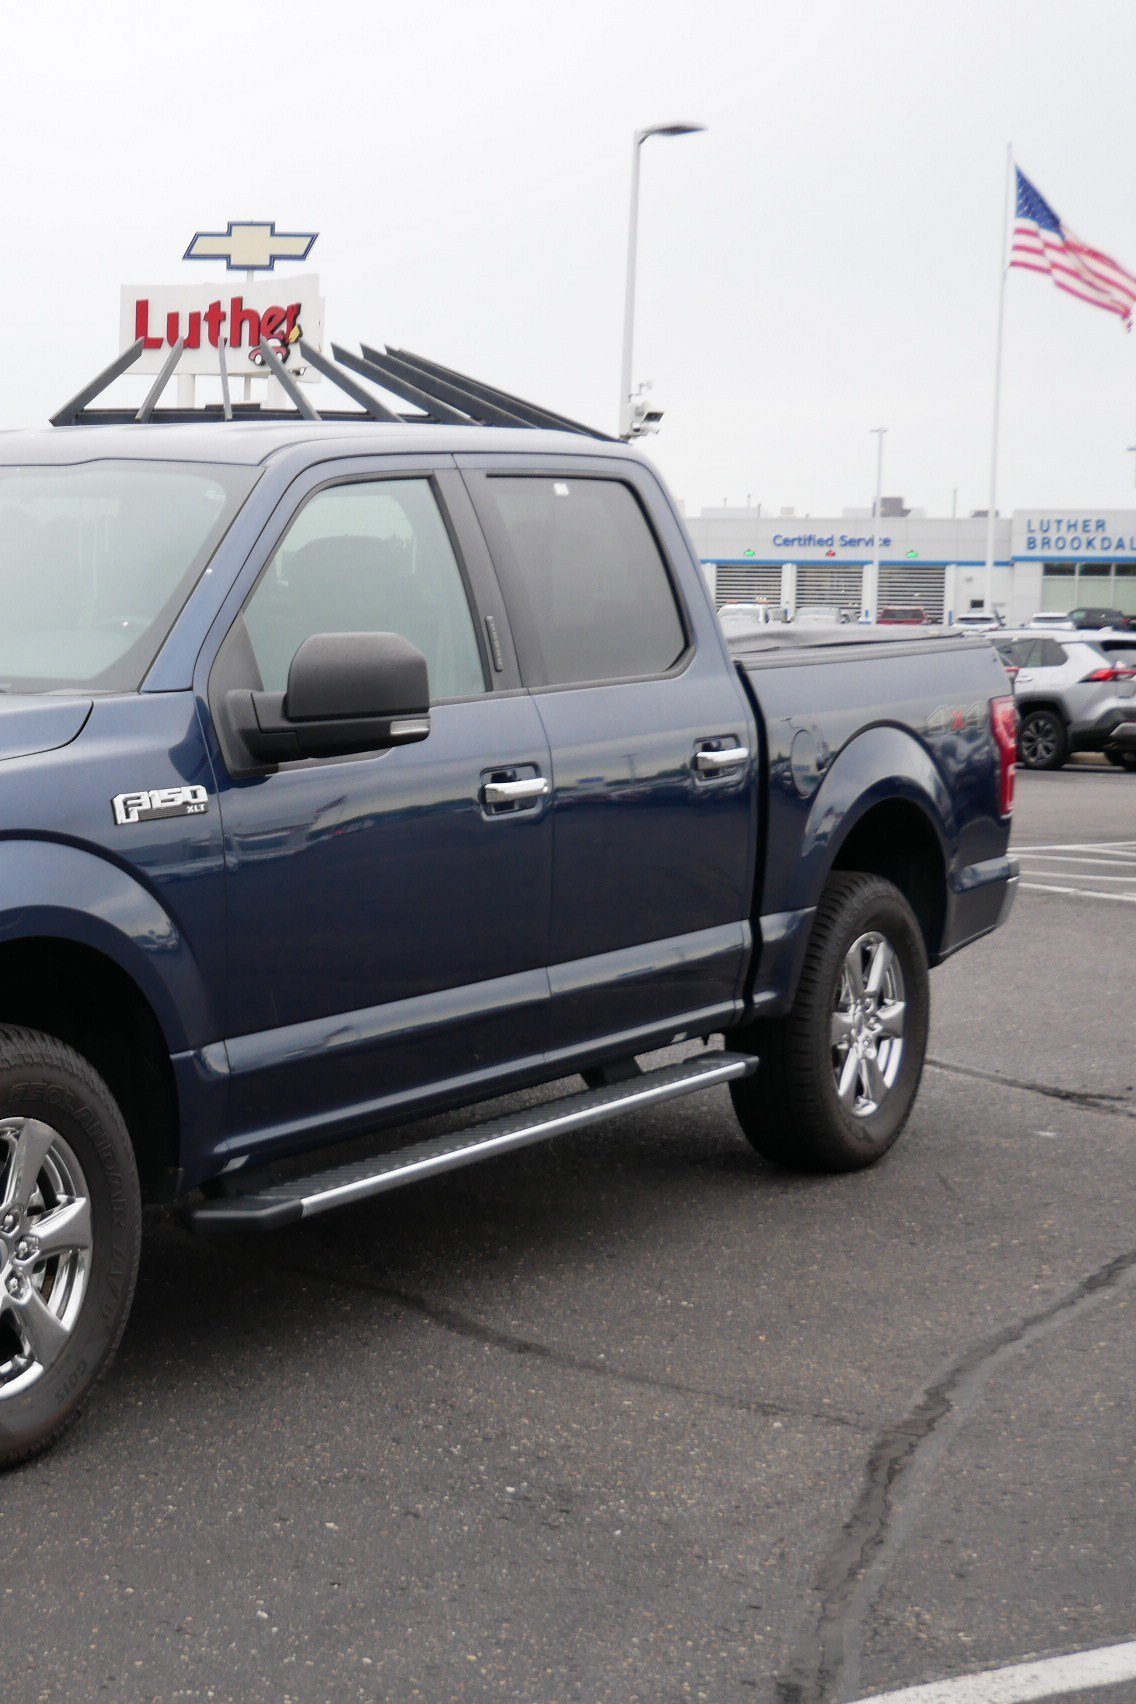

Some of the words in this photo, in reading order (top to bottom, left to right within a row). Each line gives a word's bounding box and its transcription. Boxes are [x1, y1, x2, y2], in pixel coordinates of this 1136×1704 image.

[135, 296, 302, 349] Luther
[1027, 518, 1107, 533] LUTHER
[773, 534, 834, 547] Certified
[186, 803, 206, 813] XLT
